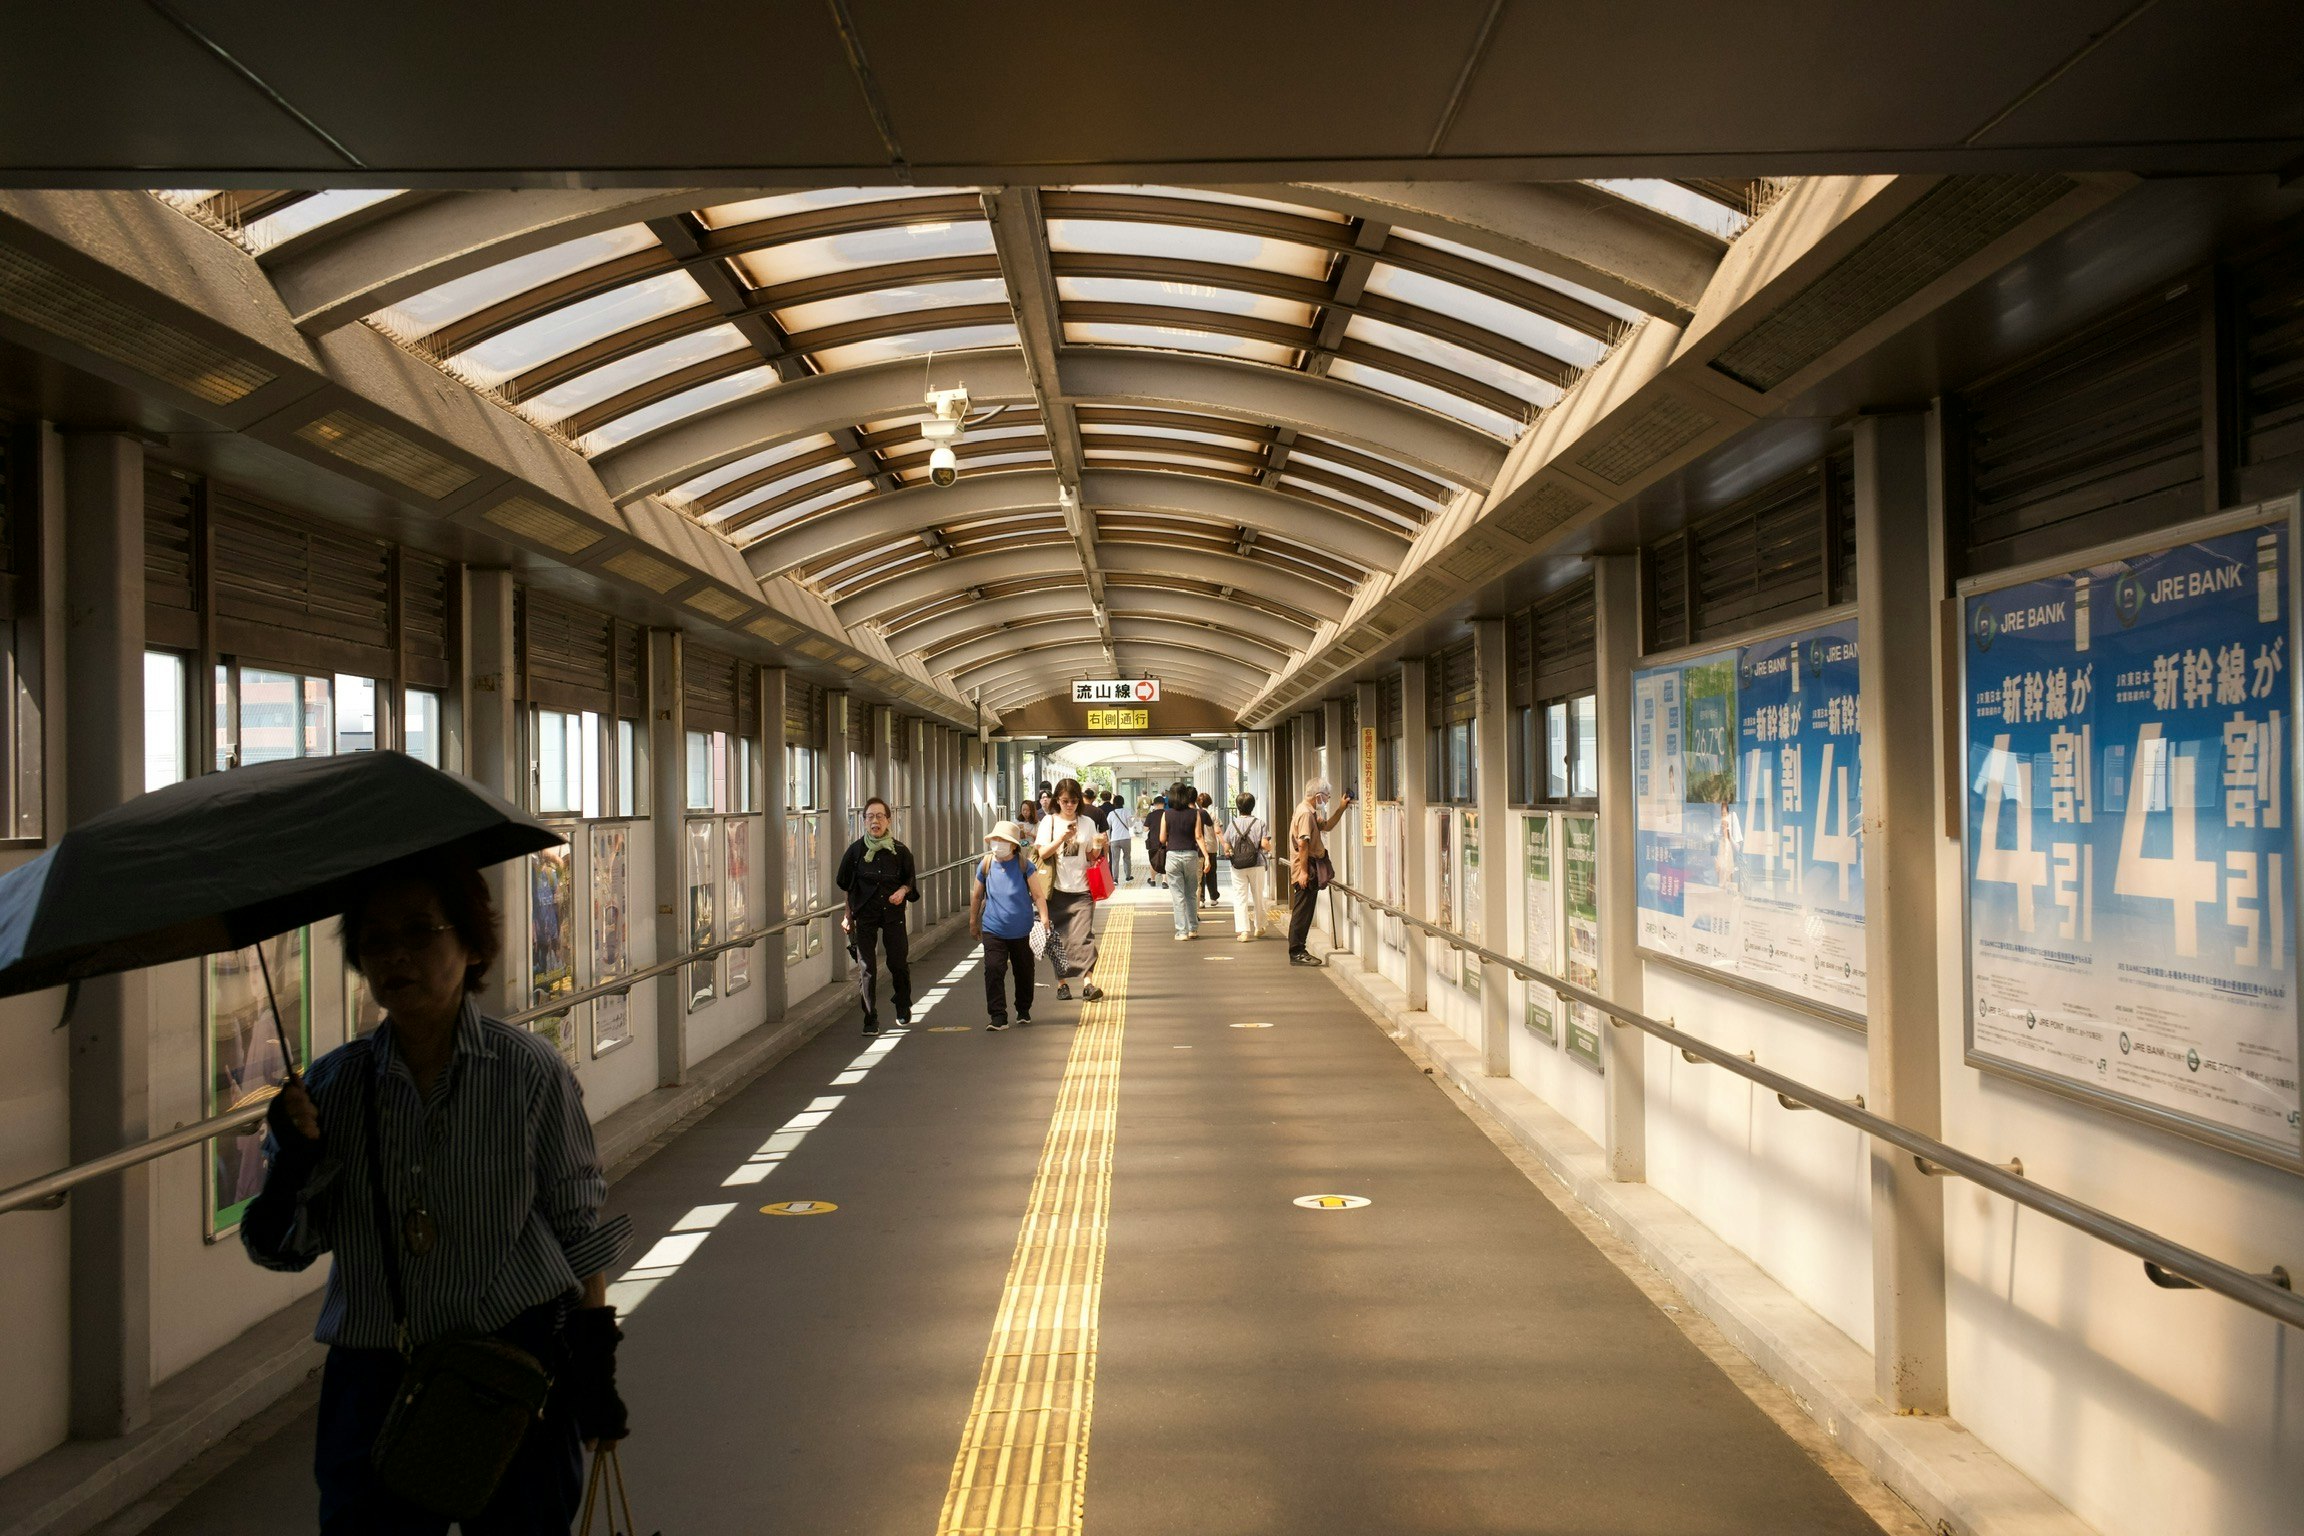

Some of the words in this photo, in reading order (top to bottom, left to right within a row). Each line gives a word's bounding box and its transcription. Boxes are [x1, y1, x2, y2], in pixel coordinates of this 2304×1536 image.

[2151, 575, 2185, 604] JRE
[2189, 563, 2243, 596] BANK
[2000, 611, 2025, 634] JRE
[2028, 602, 2066, 628] BANK
[1826, 647, 1842, 662] JRE
[1844, 642, 1859, 661] BAN
[1754, 660, 1767, 676] JRE
[1768, 657, 1787, 674] BANK
[2153, 635, 2283, 711] 新幹線が
[1077, 684, 1131, 699] 流山線
[2002, 662, 2093, 724] 新幹線が
[1089, 713, 1147, 726] 右側通行
[1756, 700, 1802, 741] 新幹線が
[2133, 1043, 2145, 1053] JRE
